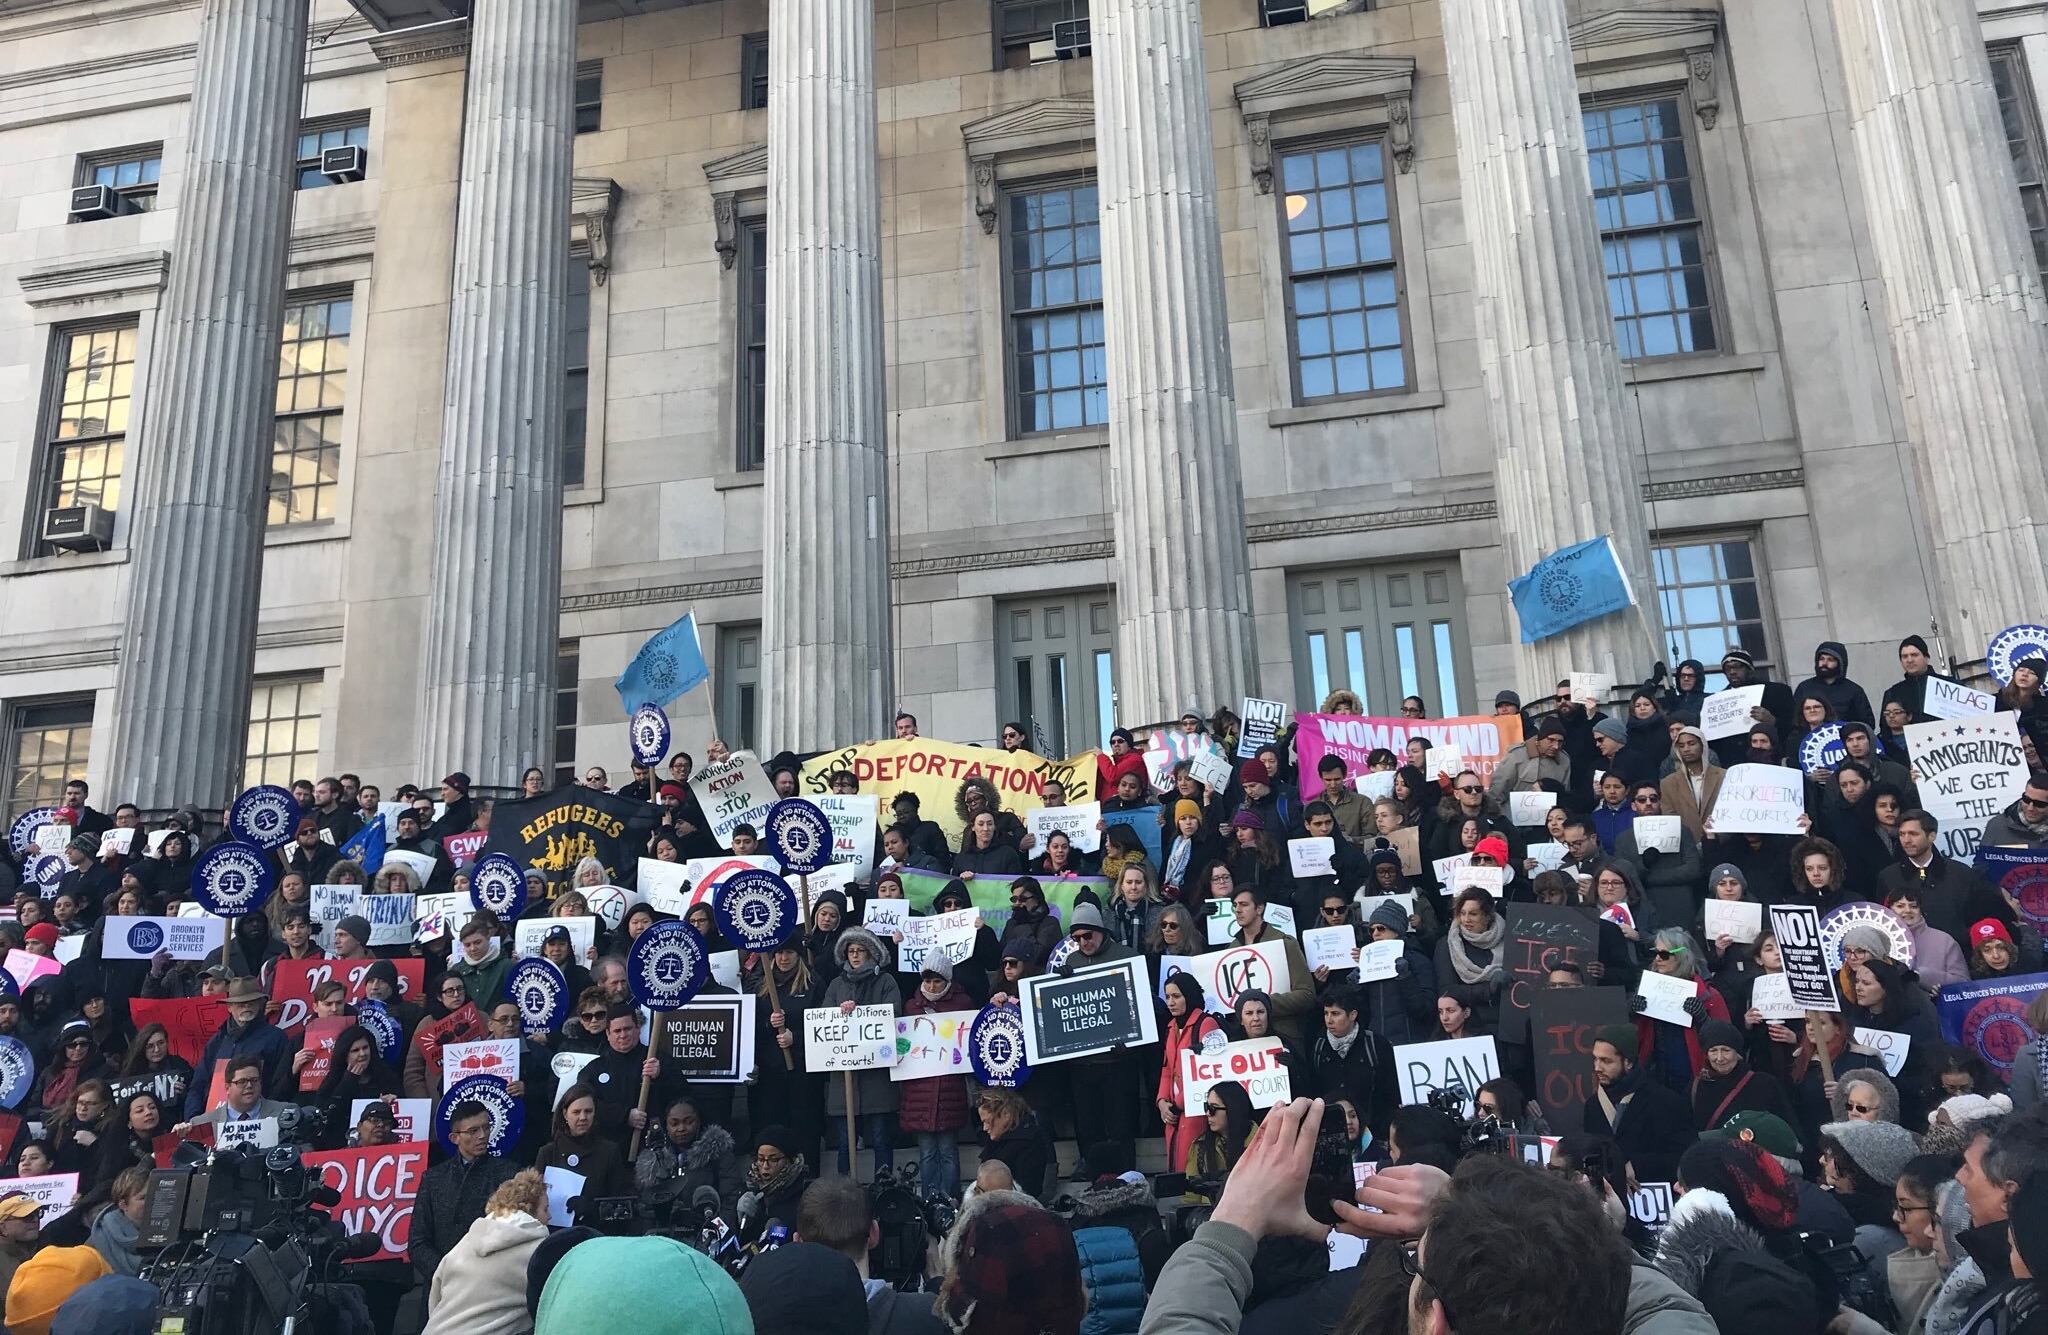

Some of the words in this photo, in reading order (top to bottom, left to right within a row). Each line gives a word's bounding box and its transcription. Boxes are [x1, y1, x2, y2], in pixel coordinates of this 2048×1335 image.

[1579, 674, 1597, 686] ICE
[1935, 681, 1988, 711] NYLAG
[1247, 700, 1281, 723] NO!
[1717, 703, 1730, 712] OUT
[1730, 701, 1738, 709] OF
[1719, 709, 1744, 721] COURTS!
[1317, 718, 1499, 758] WOMANKIND
[1913, 740, 2023, 782] IMMIGRANTS
[694, 757, 744, 783] WORKERS
[805, 748, 858, 794] STOP
[853, 752, 1047, 797] DEPORTATION
[1190, 762, 1227, 790] ICE
[708, 771, 745, 794] ACTION
[1934, 776, 1963, 796] WE
[1970, 771, 2010, 791] GET
[255, 792, 290, 805] ATTORNEYS
[724, 791, 737, 799] to
[1520, 794, 1537, 808] ICE
[715, 792, 752, 819] STOP
[820, 799, 845, 810] FULL
[1955, 797, 2001, 820] THE
[771, 812, 784, 831] LEGAL
[793, 808, 826, 834] ATTORNEYS
[1739, 808, 1790, 823] COURTS
[520, 804, 625, 845] REFUGEES
[1038, 823, 1051, 831] ICE
[1053, 822, 1068, 830] OUT
[1070, 821, 1080, 829] OF
[103, 830, 118, 840] ICE
[1940, 827, 1983, 858] JOB
[262, 841, 276, 850] UAW
[834, 838, 855, 850] ALL
[201, 858, 218, 877] LEGAL
[218, 852, 230, 860] AID
[231, 851, 266, 876] ATTORNEYS
[1985, 853, 2004, 861] LEGAL
[2004, 854, 2032, 863] SERVICES
[37, 858, 62, 883] UAW
[474, 868, 486, 886] LEGAL
[493, 862, 522, 886] ATTORNEYS
[787, 863, 799, 871] UAW
[820, 880, 828, 888] OF
[314, 886, 328, 900] NO
[330, 890, 355, 905] HUMAN
[722, 890, 736, 911] LEGAL
[735, 882, 747, 891] AID
[747, 879, 788, 903] ATTORNEYS
[422, 897, 457, 916] ICE
[591, 898, 624, 922] ICE
[649, 897, 679, 912] OUT
[1719, 903, 1740, 918] ICE
[323, 906, 350, 921] BEING
[171, 925, 206, 934] BROOKLYN
[903, 920, 933, 934] CHIEF
[933, 912, 968, 932] JUDGE
[1773, 912, 1819, 947] NO!
[170, 934, 205, 943] DEFENDER
[526, 935, 538, 943] ICE
[637, 937, 658, 959] LEGAL
[658, 931, 672, 940] AID
[672, 930, 702, 960] ATTORNEYS
[745, 940, 761, 949] UAW
[761, 938, 779, 948] 2325
[169, 943, 204, 952] SERVICES
[526, 946, 540, 954] THE
[903, 948, 929, 962] ICE
[1514, 938, 1582, 974] ICE
[1787, 962, 1798, 970] The
[1797, 963, 1820, 973] Trump/
[510, 973, 524, 994] LEGAL
[531, 967, 561, 993] ATTORNEYS
[1222, 957, 1262, 999] ICE
[1764, 976, 1782, 987] ICE
[1802, 972, 1829, 982] Regime
[1792, 980, 1809, 989] MUST
[1810, 981, 1825, 990] GO!
[1052, 996, 1070, 1009] NO
[1072, 987, 1117, 1005] HUMAN
[1753, 991, 1769, 1001] OUT
[1772, 990, 1785, 999] OF
[1943, 993, 1963, 1002] LEGAL
[1963, 989, 1989, 999] SERVICES
[1989, 986, 2008, 996] STAFF
[646, 998, 664, 1006] UAW
[664, 999, 680, 1007] 2325
[1061, 1003, 1097, 1019] BEING
[1099, 1001, 1111, 1013] IS
[806, 1010, 826, 1021] chief
[372, 1011, 395, 1046] ATTORNEYS
[667, 1021, 682, 1033] NO
[685, 1021, 724, 1033] HUMAN
[975, 1019, 988, 1042] LEGAL
[986, 1013, 997, 1023] AID
[1062, 1014, 1112, 1033] ILLEGAL
[672, 1034, 704, 1045] BEING
[707, 1034, 718, 1045] IS
[813, 1026, 850, 1043] KEEP
[859, 1023, 885, 1040] ICE
[1862, 1031, 1893, 1050] NO
[464, 1046, 481, 1055] FAST
[482, 1045, 500, 1053] FOOD
[672, 1047, 717, 1058] ILLEGAL
[313, 1058, 329, 1069] NO
[825, 1058, 837, 1067] of
[841, 1053, 875, 1065] courts!
[1189, 1054, 1223, 1082] ICE
[1230, 1048, 1284, 1075] OUT
[450, 1070, 482, 1079] FREEDOM
[483, 1066, 515, 1075] FIGHTERS
[455, 1080, 492, 1096] ASSOCIATION
[1252, 1074, 1289, 1096] COURT
[444, 1097, 461, 1121] LEGAL
[460, 1087, 474, 1098] AID
[474, 1085, 515, 1109] ATTORNEYS
[222, 1125, 234, 1134] NO
[237, 1122, 262, 1133] HUMAN
[355, 1153, 421, 1199] ICE
[24, 1182, 51, 1190] Defenders
[37, 1191, 52, 1200] OF
[342, 1204, 414, 1253] NYC
